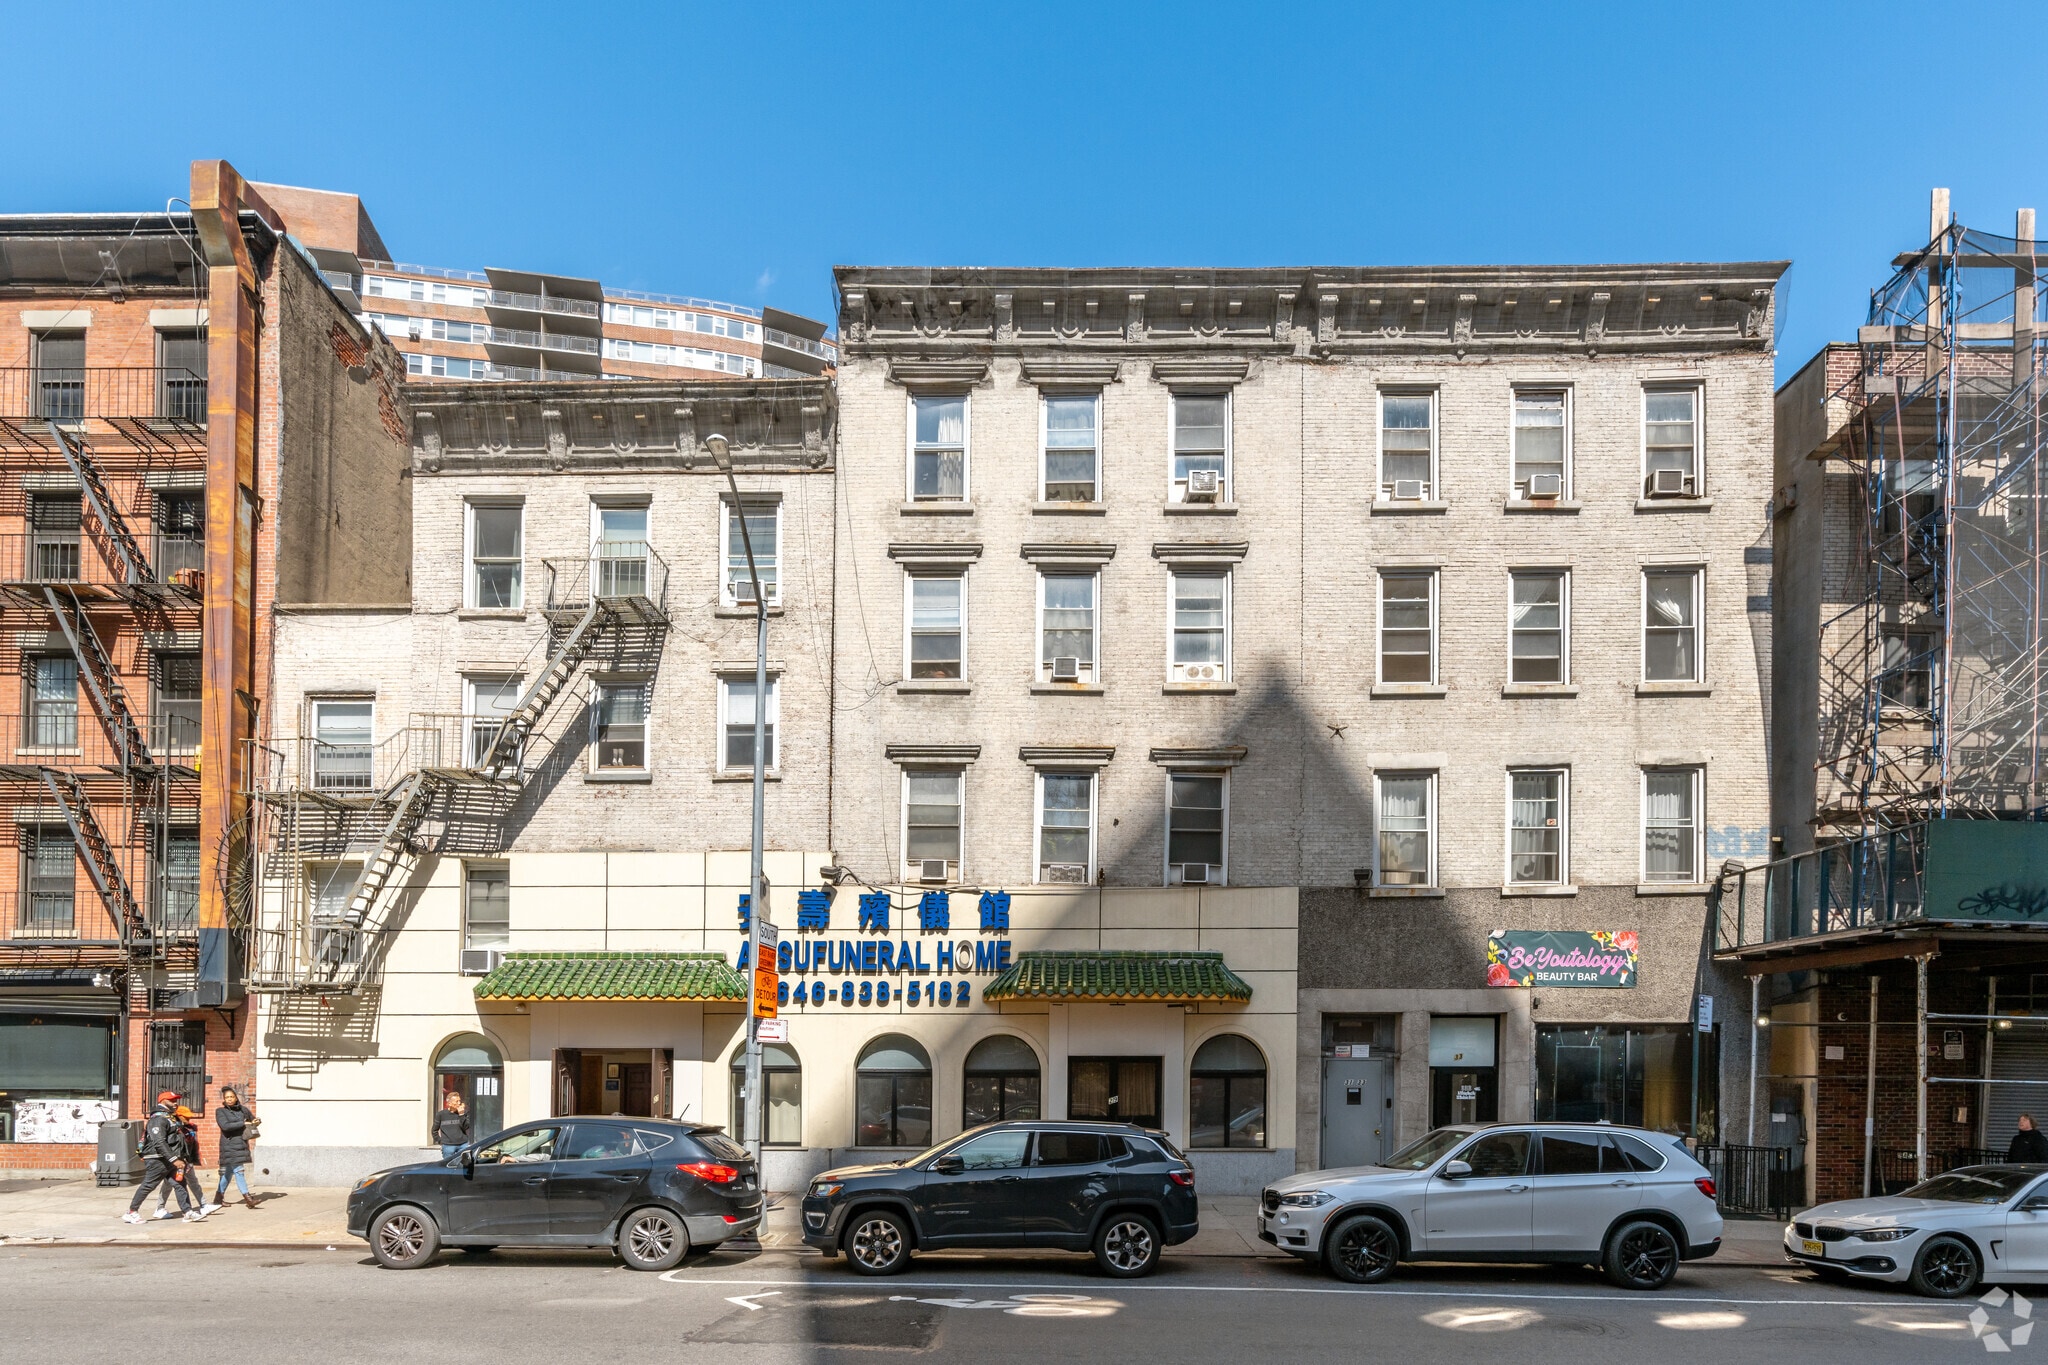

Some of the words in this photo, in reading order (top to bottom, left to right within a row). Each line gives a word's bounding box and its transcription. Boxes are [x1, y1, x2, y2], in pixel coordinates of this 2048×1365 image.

[760, 926, 777, 941] SOUTH
[937, 940, 1012, 970] HOME
[1536, 972, 1575, 981] BEAUTY
[1577, 972, 1598, 981] BAR
[756, 988, 776, 1001] DETOUR
[778, 981, 971, 1001] 646-838-5182
